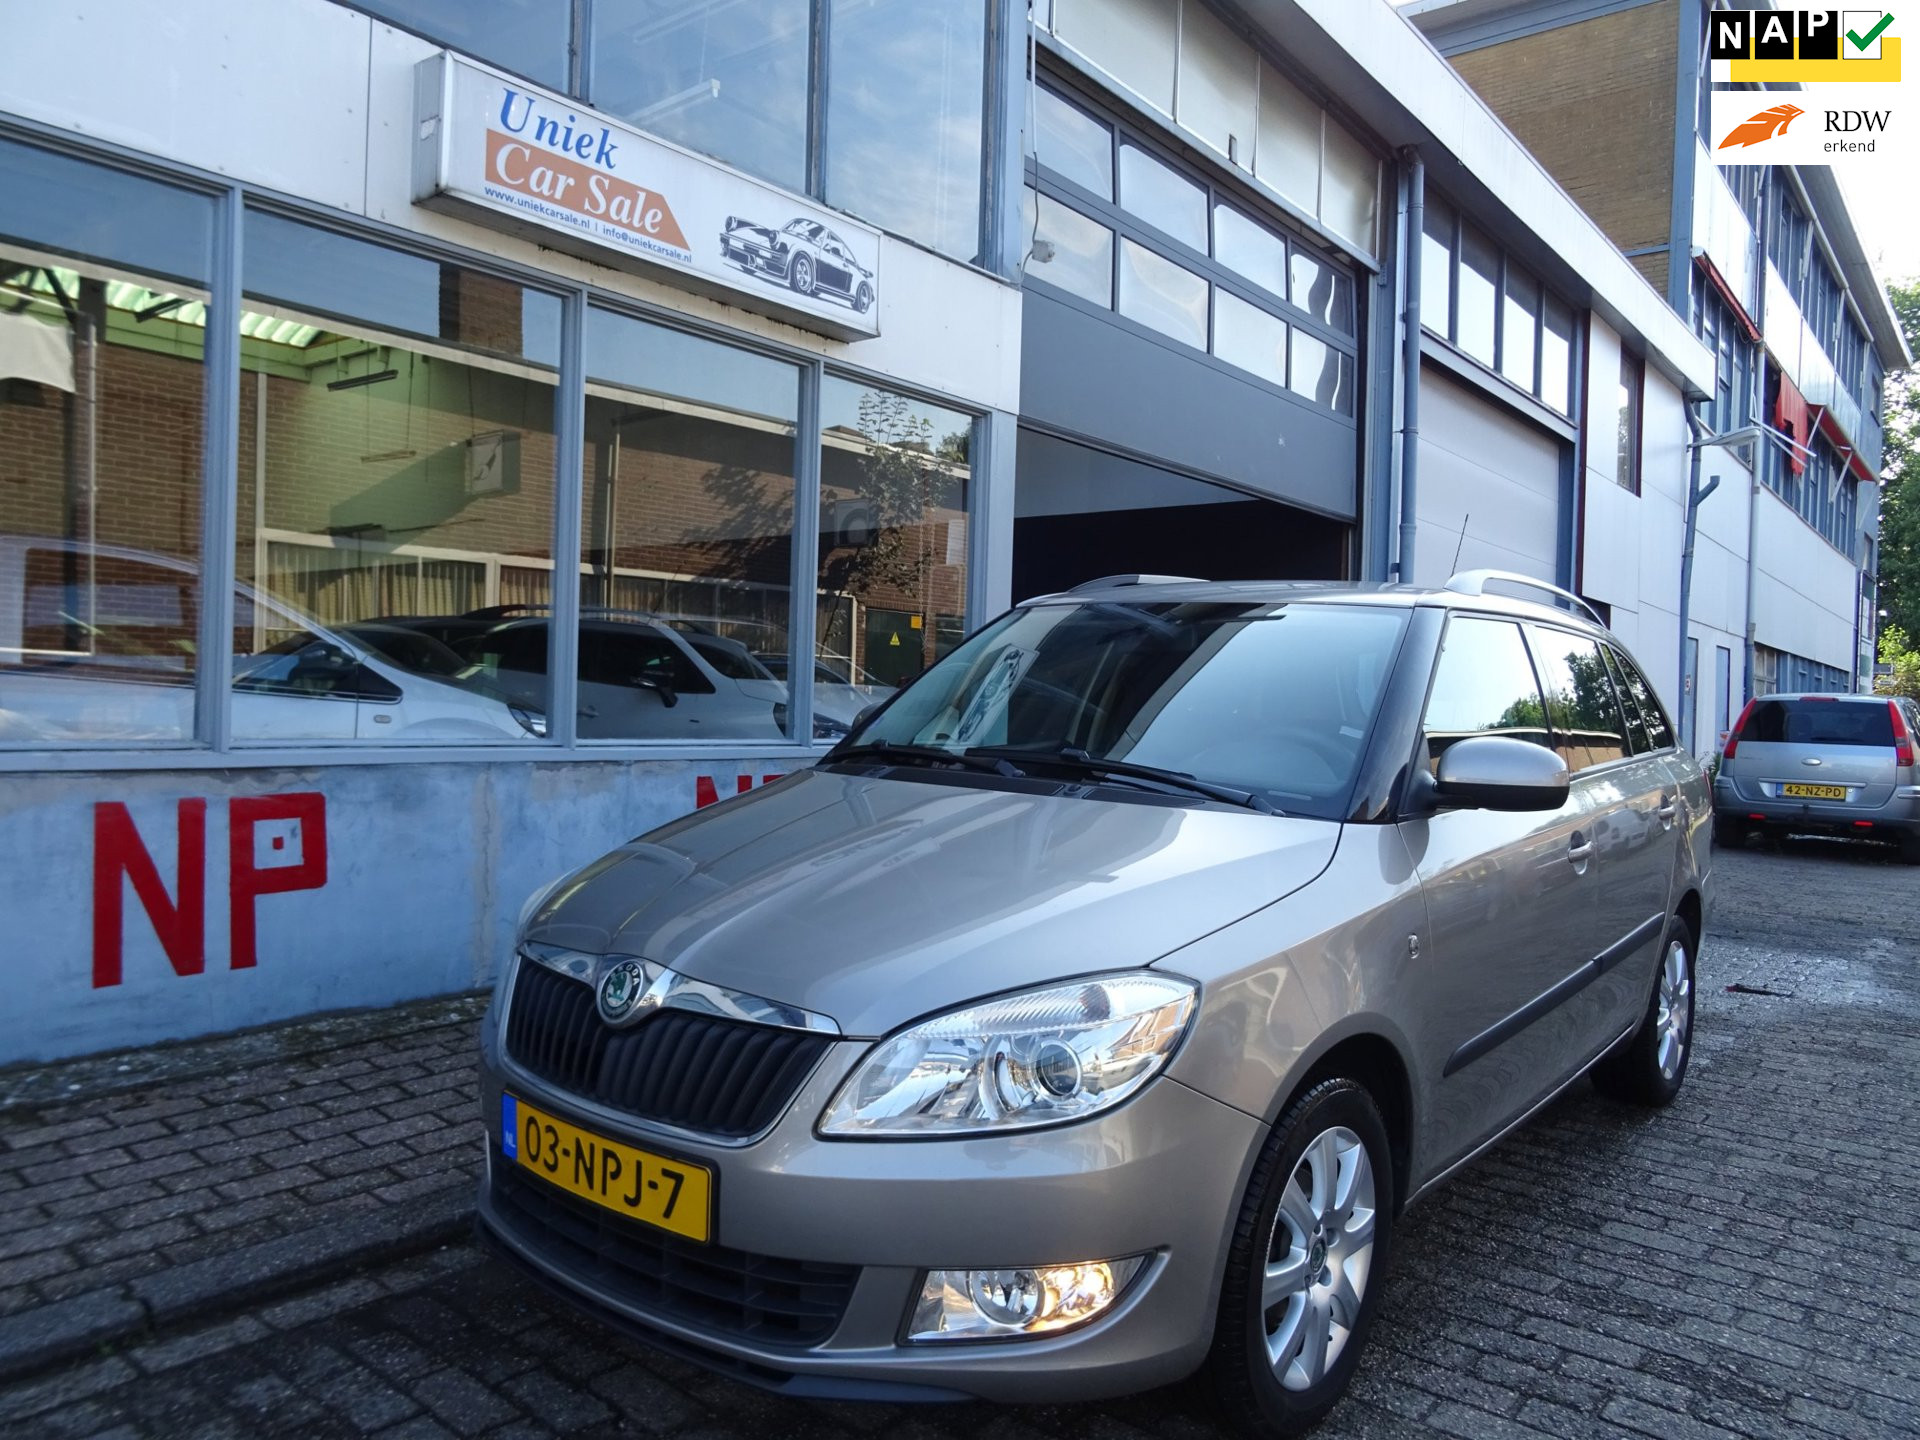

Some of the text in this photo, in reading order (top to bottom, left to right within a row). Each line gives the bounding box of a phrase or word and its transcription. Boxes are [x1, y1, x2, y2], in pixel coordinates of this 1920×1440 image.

[501, 87, 618, 169] Uniek
[484, 186, 692, 263] www.uniekcarsale.nl info@uniekcarsale.nl
[496, 143, 663, 234] Car Sale
[1786, 785, 1842, 798] 42-NZ-PD
[93, 792, 328, 989] NP
[525, 1115, 685, 1220] 03-NPJ-7
